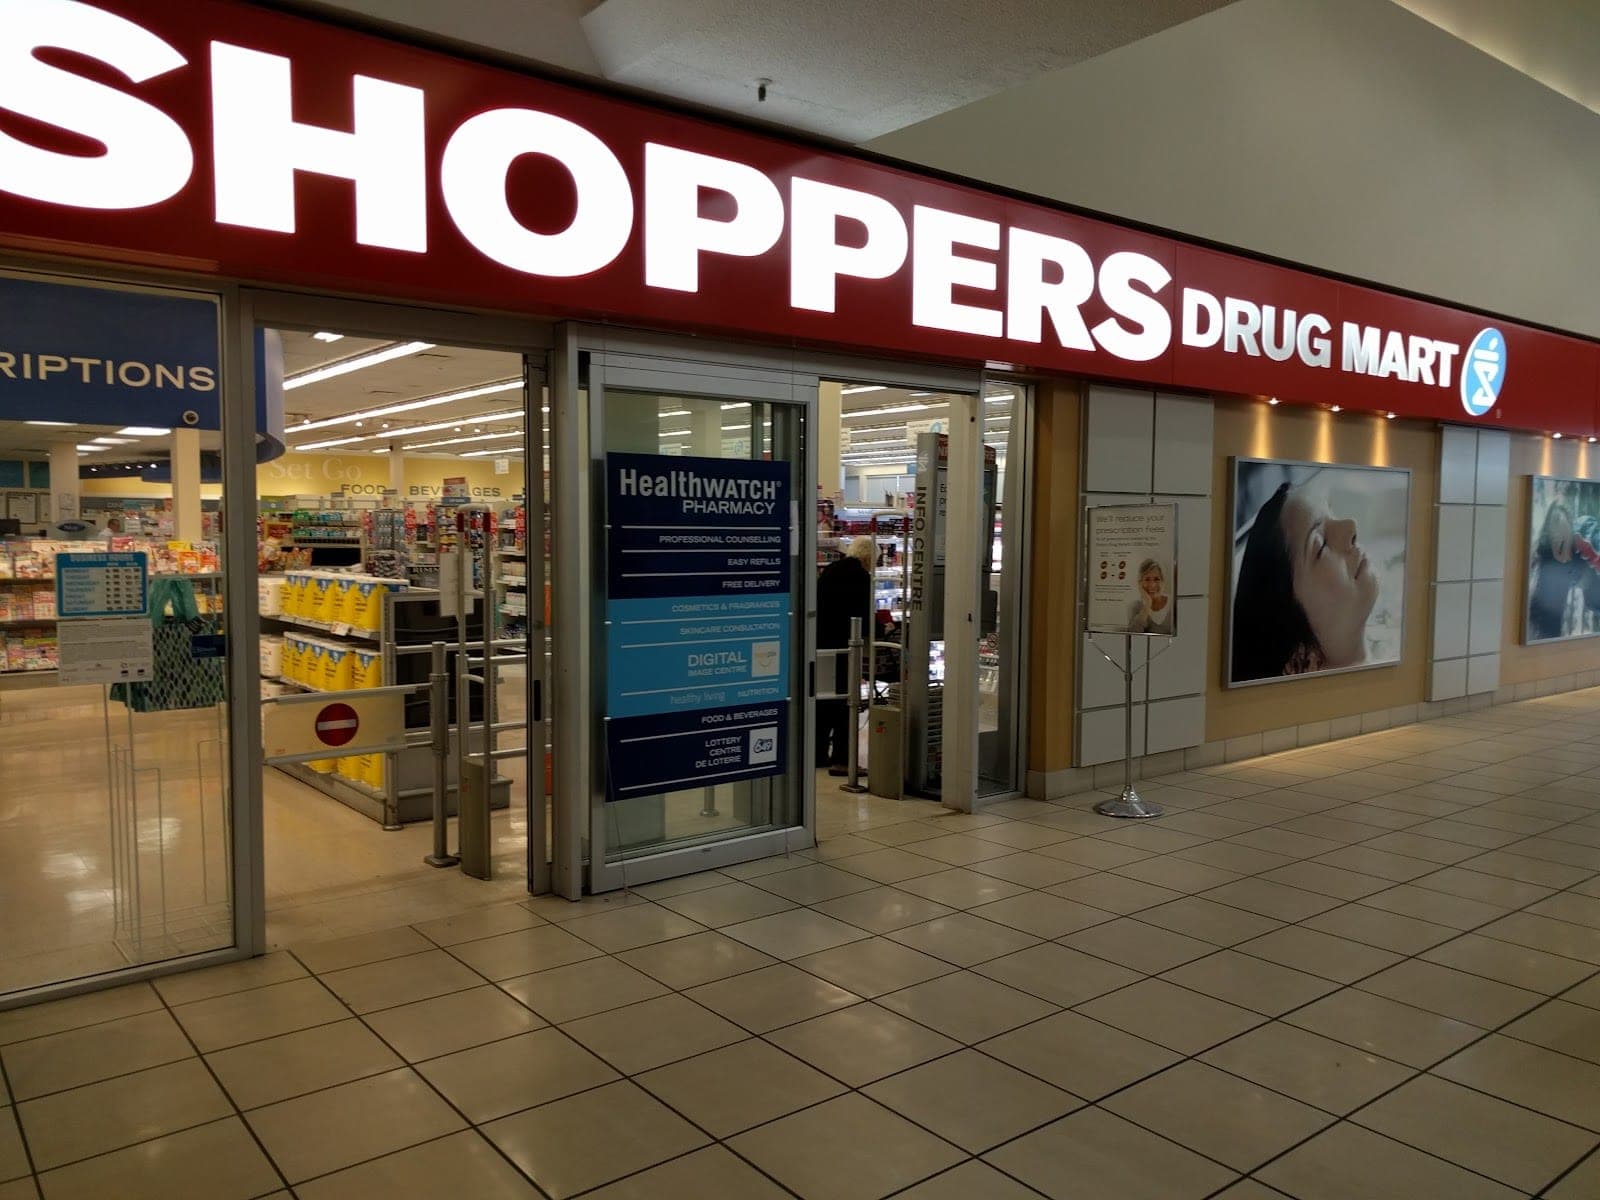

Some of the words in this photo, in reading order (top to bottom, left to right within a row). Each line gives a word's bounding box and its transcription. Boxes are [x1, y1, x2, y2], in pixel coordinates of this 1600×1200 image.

[0, 0, 1173, 362] SHOPPERS
[1182, 287, 1332, 369] DRUG
[1342, 321, 1459, 388] MART
[0, 351, 216, 392] RIPTIONS
[321, 457, 362, 481] Go
[341, 484, 387, 495] FOOD
[682, 500, 776, 515] PHARMACY
[915, 486, 927, 531] INFO
[1145, 525, 1166, 534] fees
[659, 535, 724, 544] PROFESSIONAL
[725, 535, 781, 544] COUNSELLING
[728, 558, 748, 566] EASY
[750, 557, 781, 566] REFILLS
[912, 537, 925, 611] CENTRE
[744, 579, 781, 588] DELIVERY
[671, 603, 720, 613] COSMETICS
[729, 600, 781, 610] FRAGRANCES
[679, 626, 721, 635] SKINCARE
[722, 622, 781, 633] CONSULTATION
[688, 651, 747, 668] DIGITAL
[688, 667, 713, 677] IMAGE
[714, 665, 747, 675] CENTRE
[671, 692, 702, 705] healthy
[703, 691, 726, 702] living
[737, 687, 779, 698] NUTRITION
[701, 714, 724, 724] FOOD
[733, 708, 779, 720] BEVERAGES
[704, 735, 742, 748] LOTTERY
[709, 746, 742, 757] CENTRE
[695, 759, 707, 769] DE
[708, 755, 742, 767] LOTERIE
